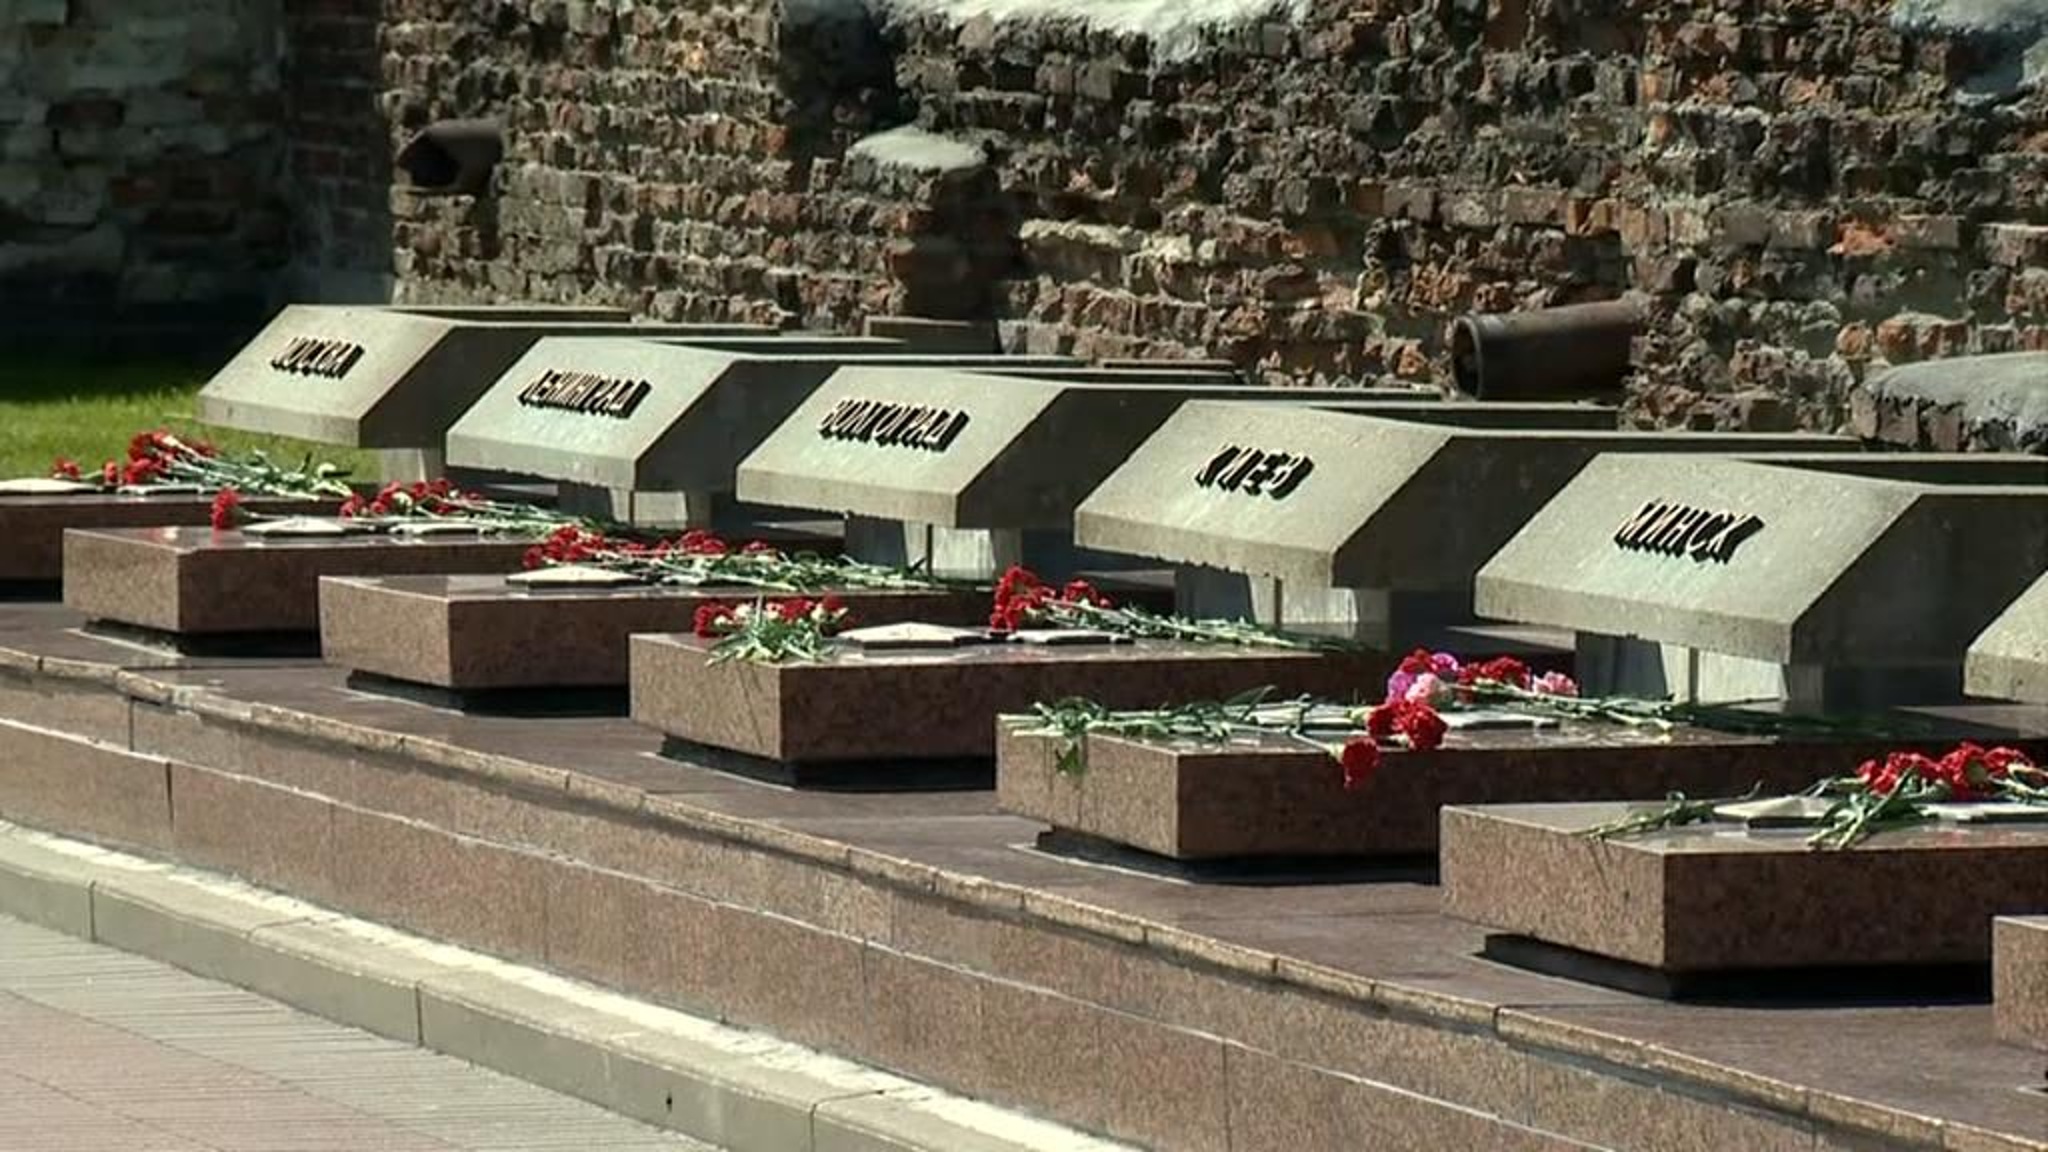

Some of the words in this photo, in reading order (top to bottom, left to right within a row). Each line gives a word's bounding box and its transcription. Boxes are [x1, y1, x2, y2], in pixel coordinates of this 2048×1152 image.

[517, 369, 653, 419] ЛЕНИНГРАД
[818, 399, 970, 452] ВОЛГОГРАД
[1194, 443, 1315, 500] КИЕВ
[1613, 498, 1765, 565] МИНСК
